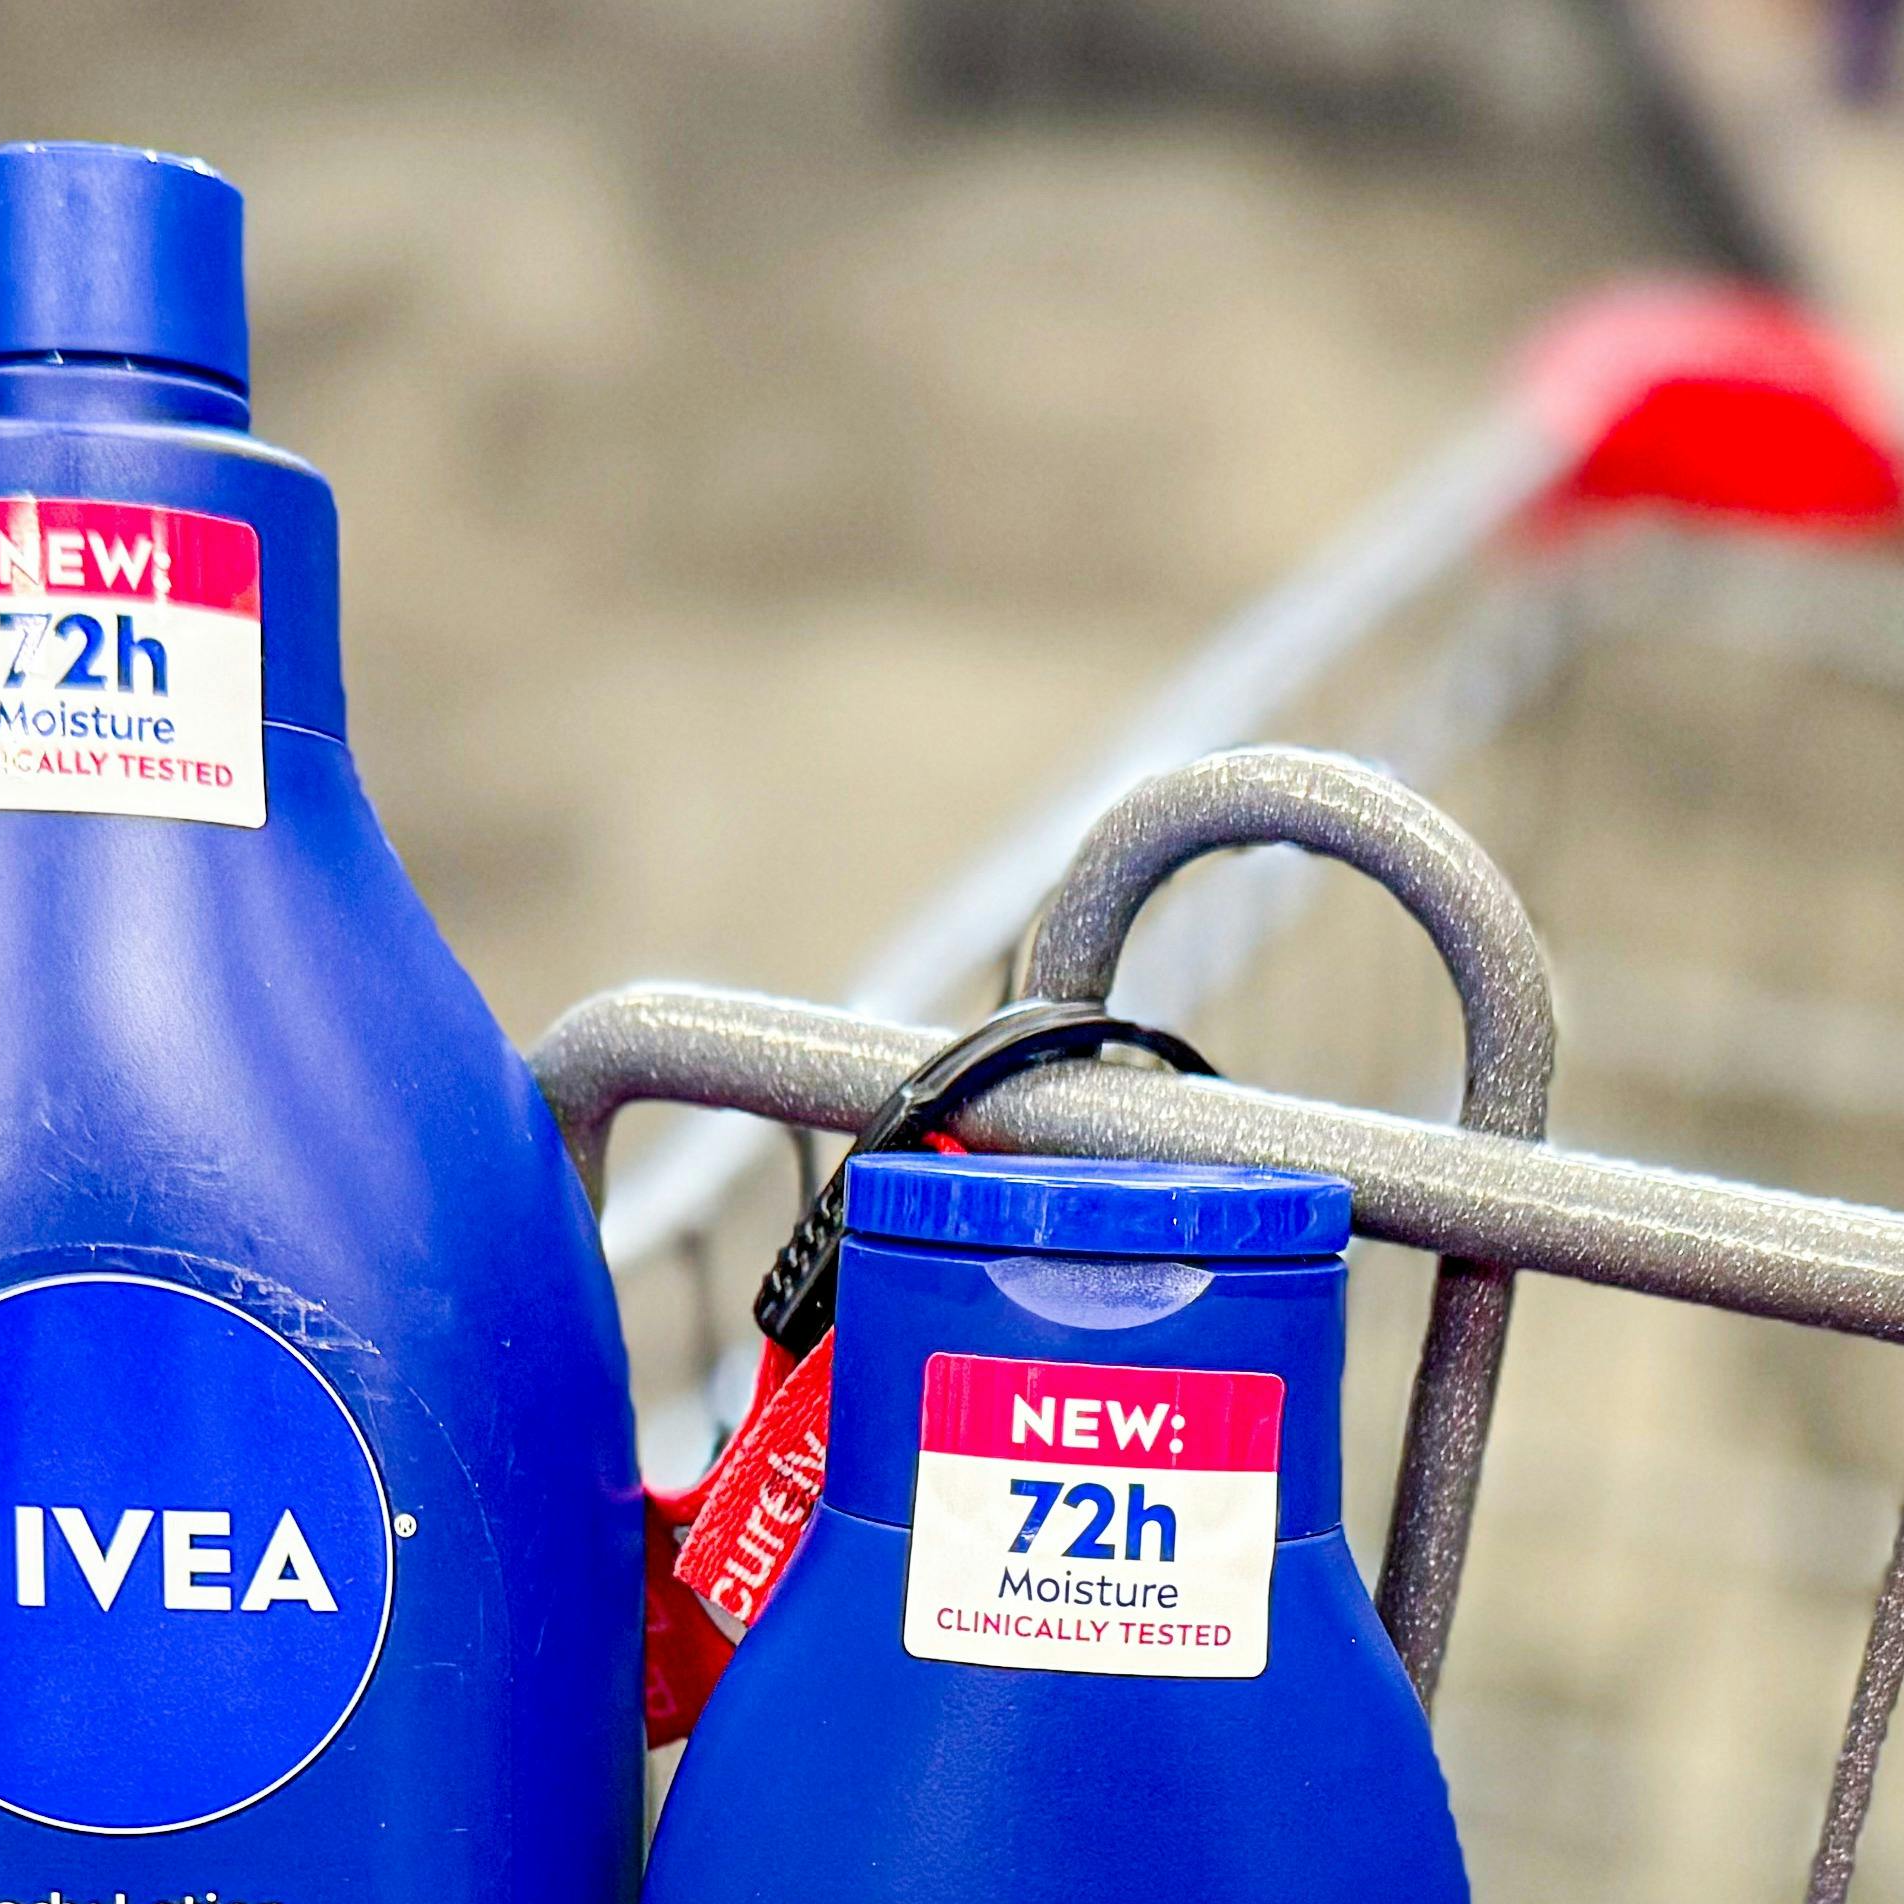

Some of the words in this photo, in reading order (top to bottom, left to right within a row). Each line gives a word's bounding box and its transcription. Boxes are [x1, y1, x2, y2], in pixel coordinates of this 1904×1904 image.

[0, 612, 169, 697] 72h
[118, 752, 234, 788] TESTED
[1011, 1394, 1187, 1454] NEW:
[1008, 1478, 1177, 1563] 72h
[997, 1568, 1179, 1609] Moisture
[937, 1608, 1108, 1643] CLINICALLY
[1119, 1621, 1232, 1647] TESTED
